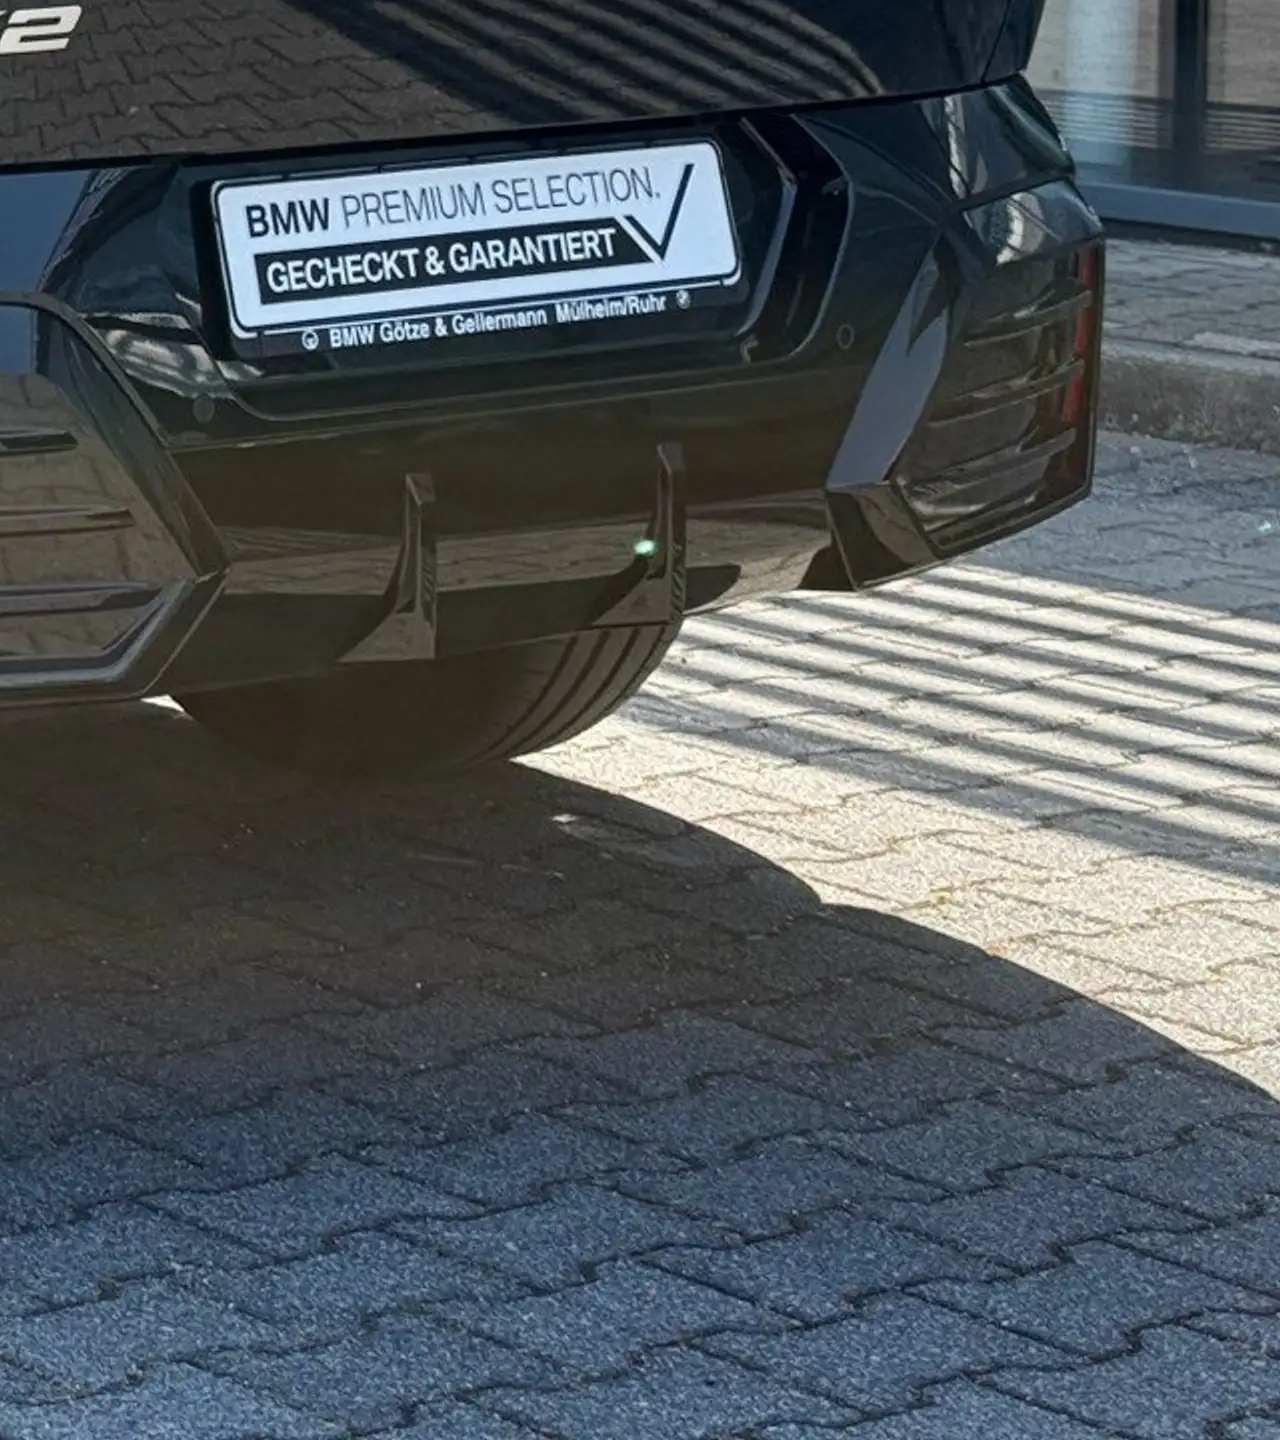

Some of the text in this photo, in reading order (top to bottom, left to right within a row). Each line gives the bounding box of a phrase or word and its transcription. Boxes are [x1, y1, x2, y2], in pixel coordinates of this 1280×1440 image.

[246, 197, 330, 238] BMW
[341, 181, 486, 228] PREMIUM
[266, 227, 616, 292] GECHECKT & GARANTIERT
[329, 294, 667, 348] BMW Götze & Gellermann Mülheim/Ruhr
